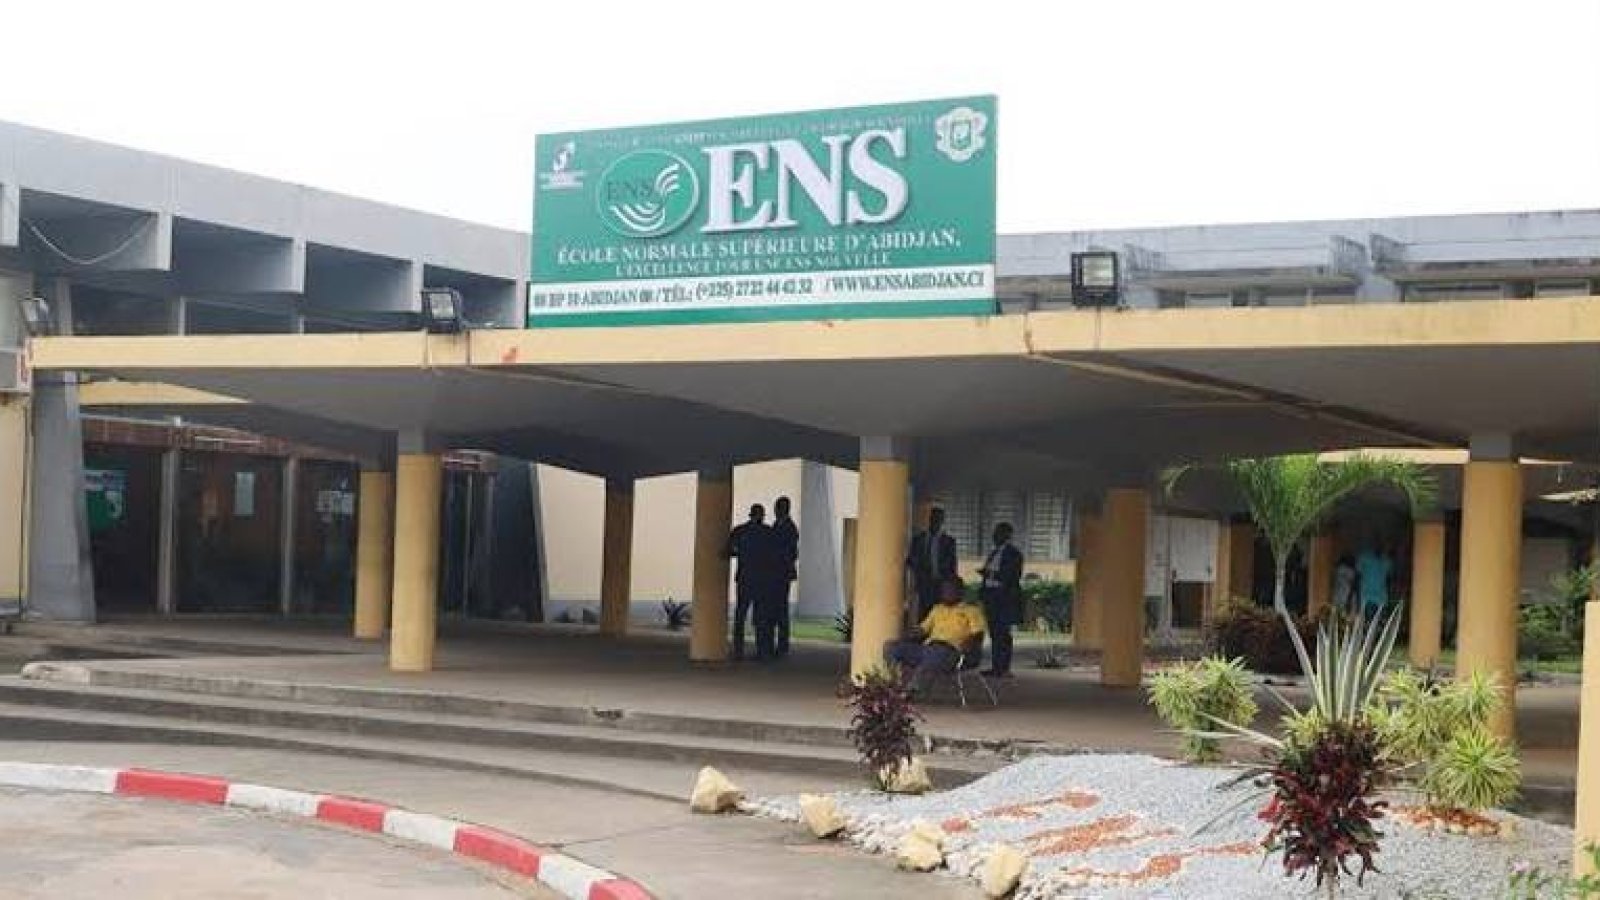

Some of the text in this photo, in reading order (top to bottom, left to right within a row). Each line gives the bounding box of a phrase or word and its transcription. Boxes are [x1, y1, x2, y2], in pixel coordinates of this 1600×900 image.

[700, 127, 908, 232] ENS
[557, 244, 618, 265] ÉCOLE
[622, 241, 714, 261] NORMALE
[718, 232, 837, 257] SUPÉRIEURE
[581, 287, 638, 305] ABIDJAN
